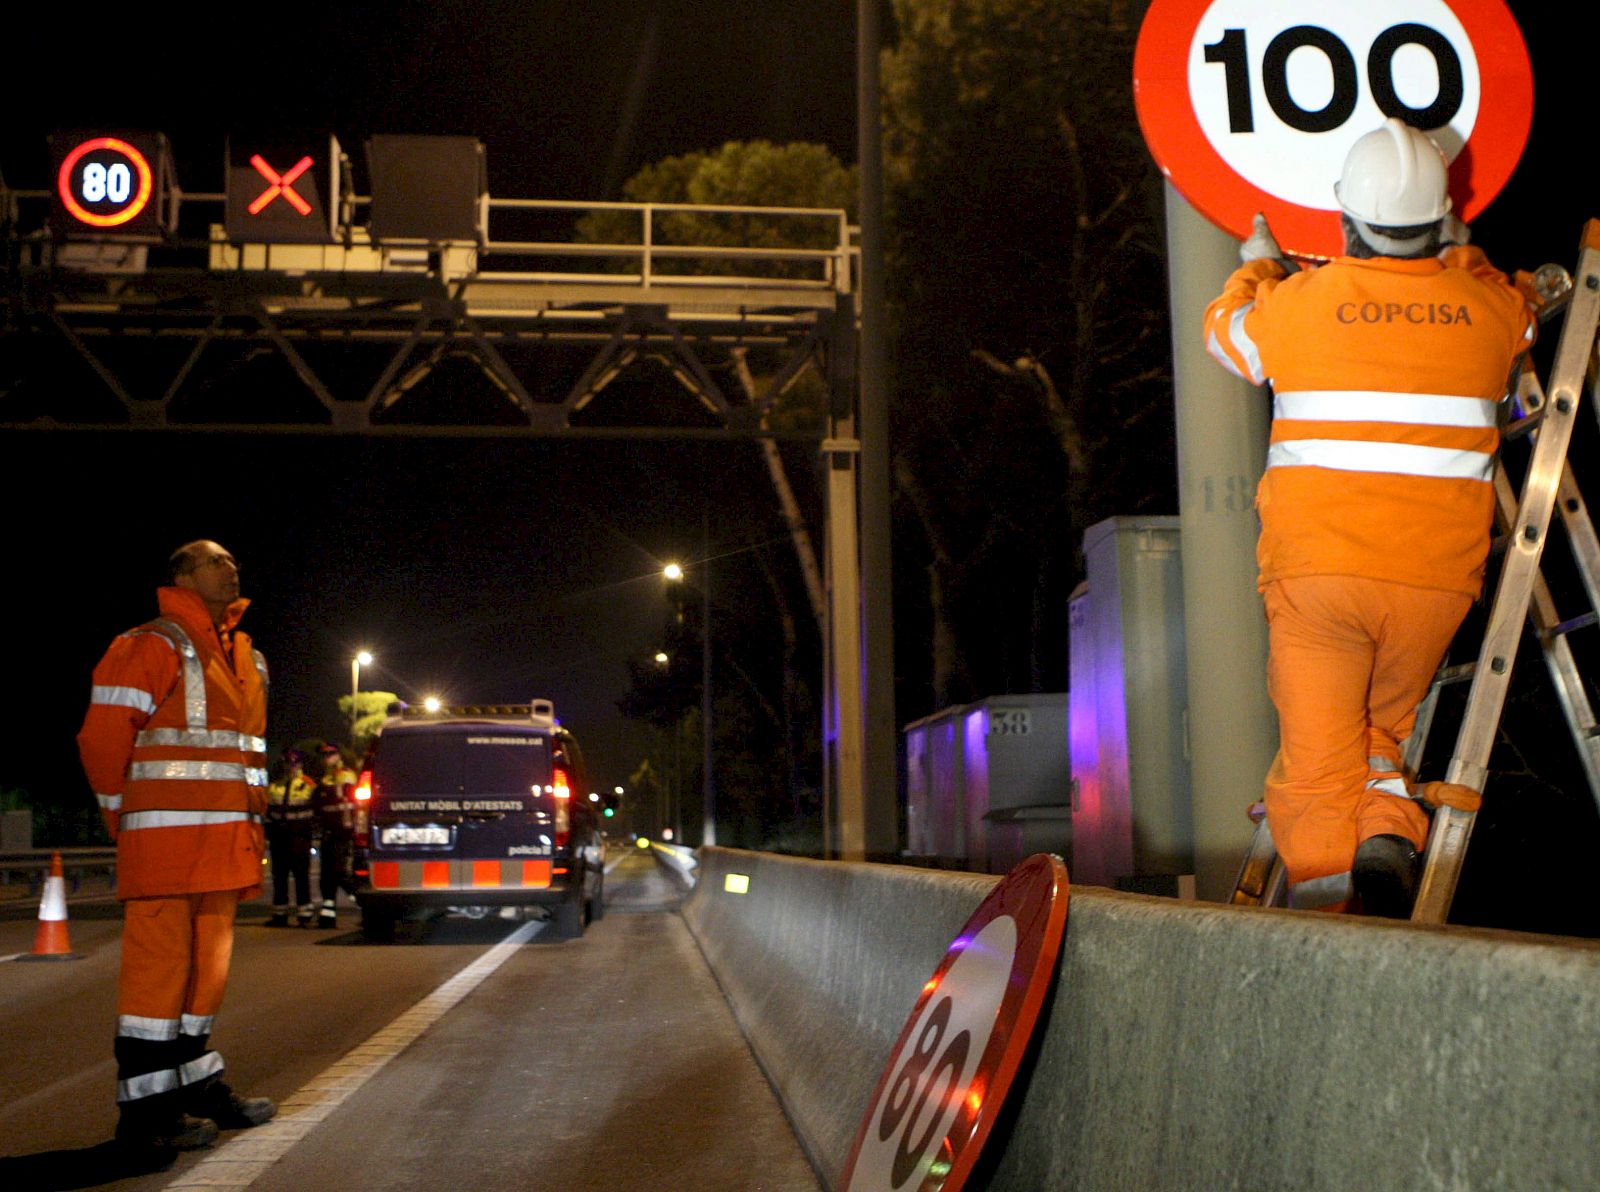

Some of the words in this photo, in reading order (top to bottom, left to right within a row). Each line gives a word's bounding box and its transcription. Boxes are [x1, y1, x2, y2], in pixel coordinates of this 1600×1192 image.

[1204, 22, 1464, 133] 100
[82, 163, 131, 203] 80
[1336, 302, 1472, 326] COPCISA
[390, 801, 426, 811] UNITAT
[463, 801, 523, 811] D'ATESTATS
[879, 996, 971, 1189] 80
